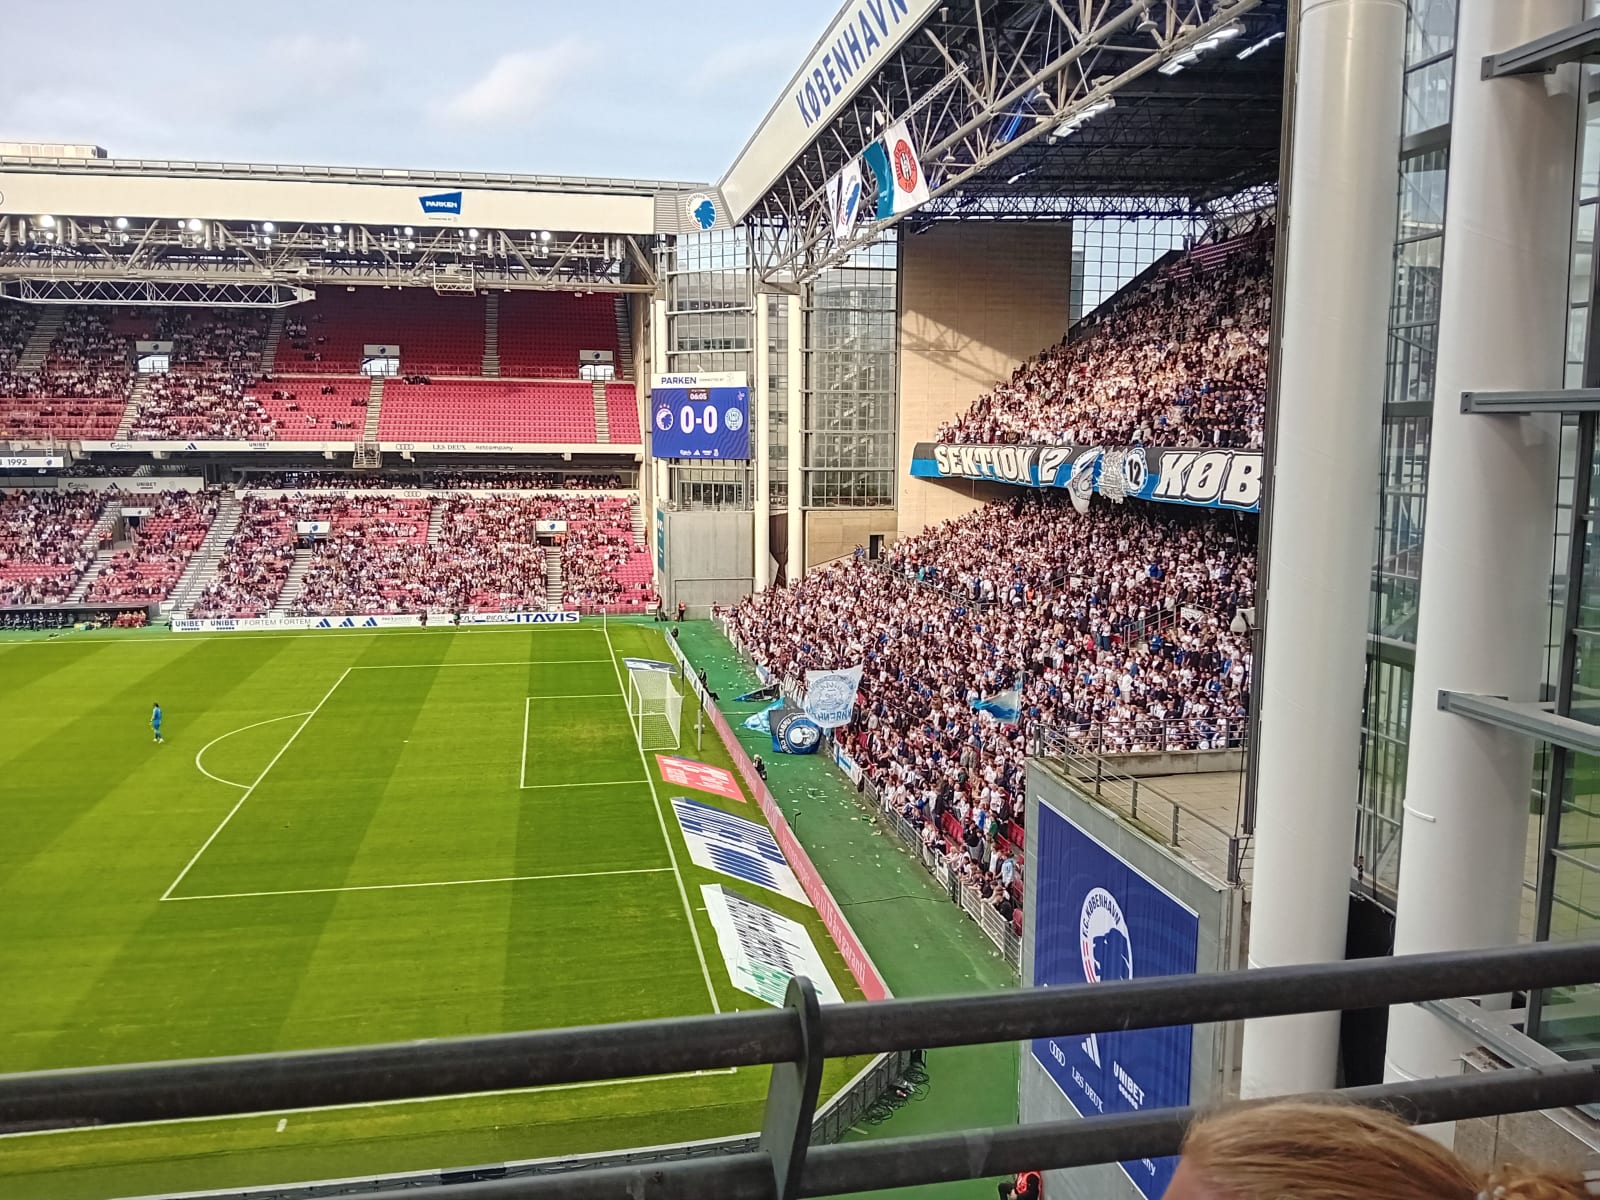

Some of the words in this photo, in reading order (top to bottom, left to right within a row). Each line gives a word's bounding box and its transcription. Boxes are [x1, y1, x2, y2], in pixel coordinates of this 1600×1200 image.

[425, 200, 458, 209] PARKEN
[661, 376, 697, 385] PARKEN
[7, 458, 28, 466] 1992
[934, 444, 1036, 485] SEKTION
[1128, 458, 1141, 486] 12
[516, 612, 577, 623] ITAVIS
[1085, 893, 1121, 926] KØBENHAVN
[827, 902, 833, 928] 15
[841, 935, 866, 985] garanti
[1071, 1065, 1085, 1089] LES
[1084, 1081, 1104, 1114] DEUX
[1113, 1060, 1145, 1106] UNIBET
